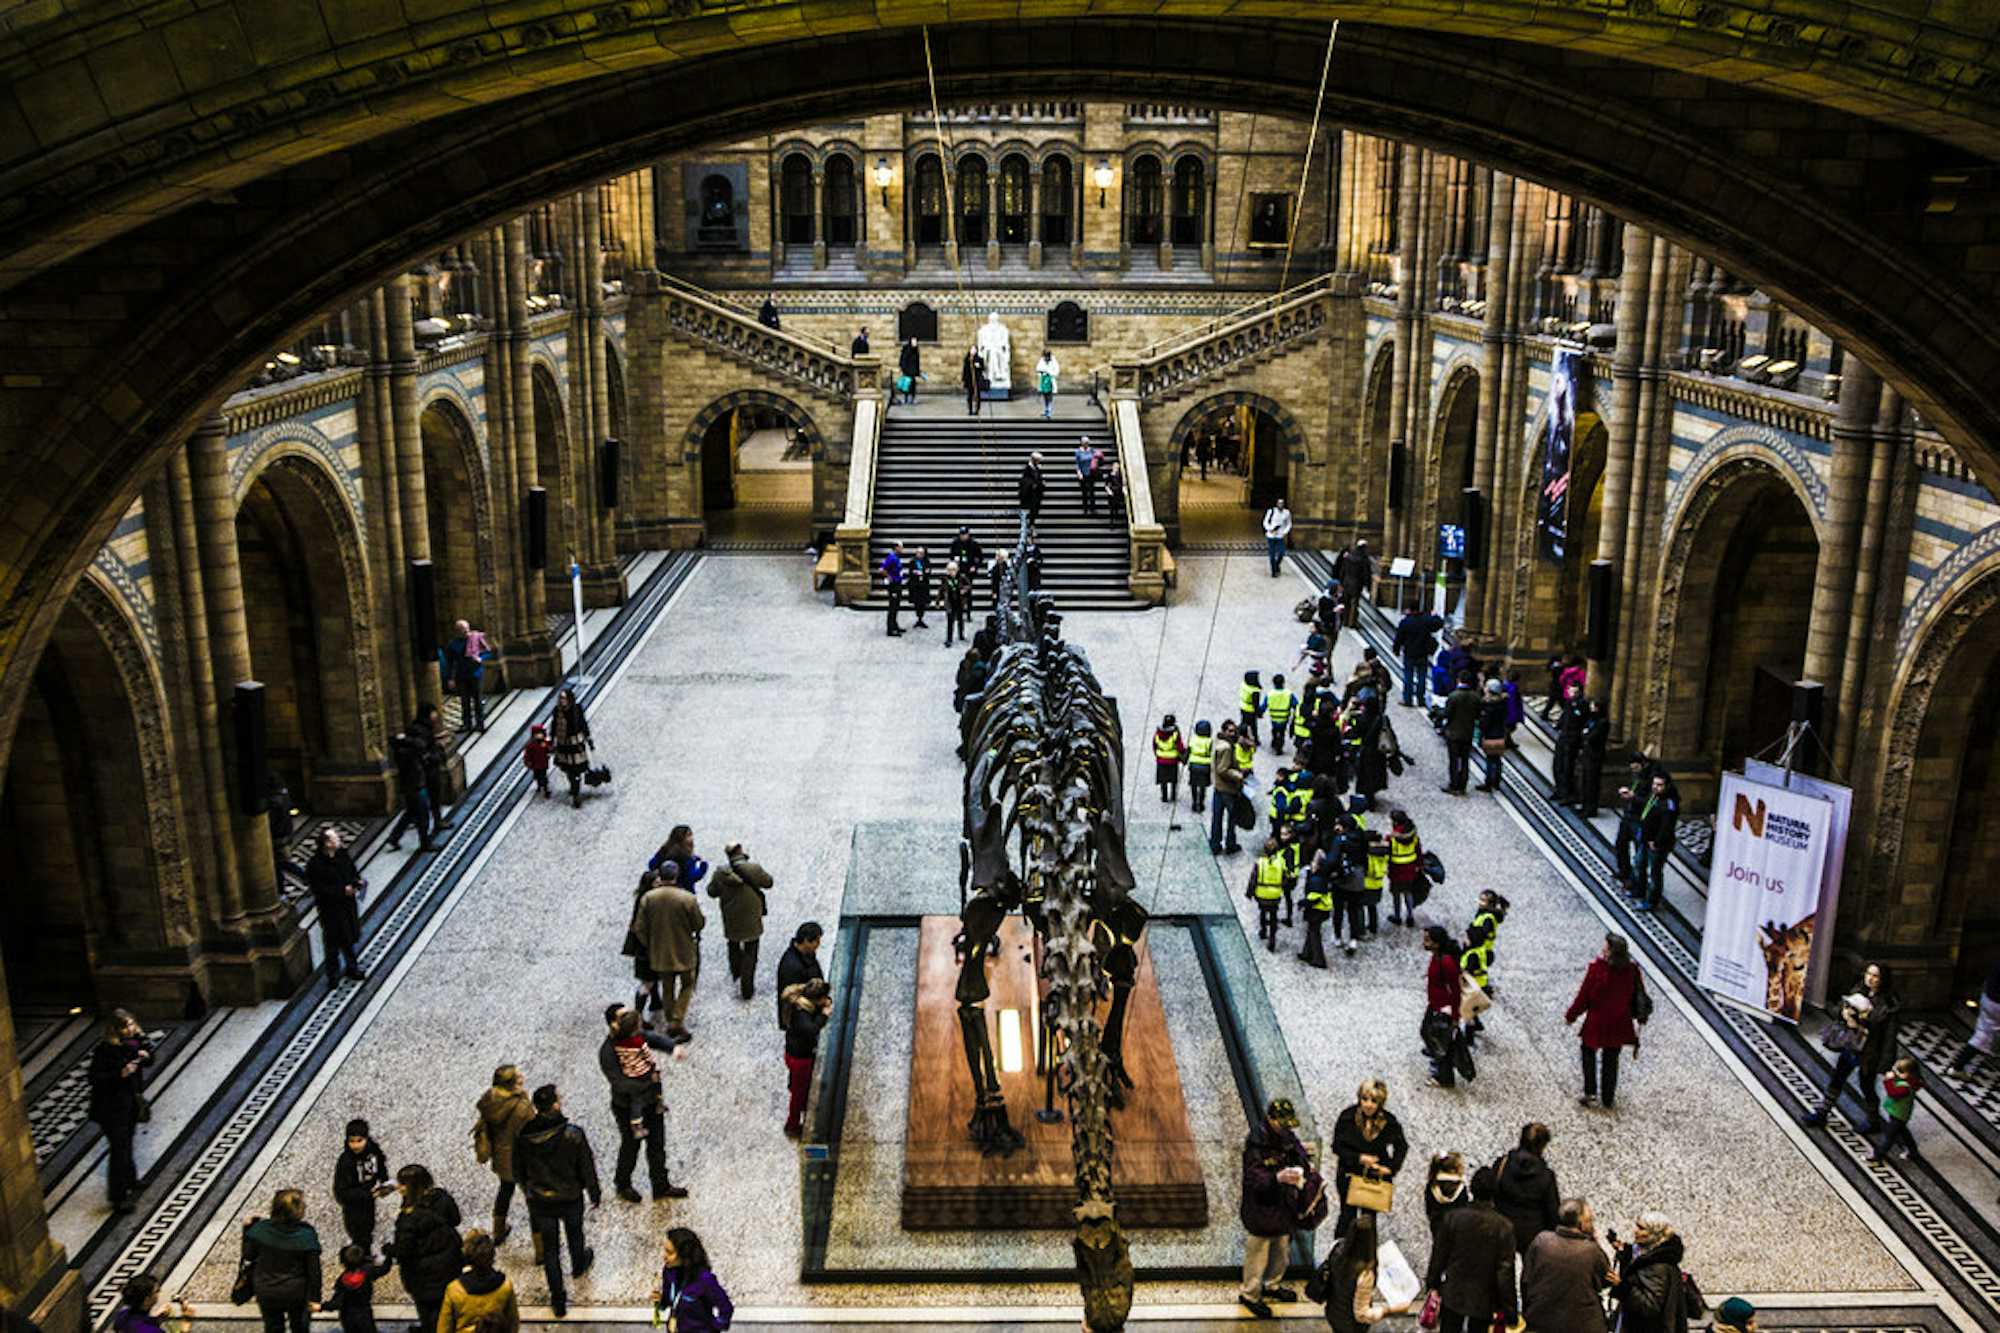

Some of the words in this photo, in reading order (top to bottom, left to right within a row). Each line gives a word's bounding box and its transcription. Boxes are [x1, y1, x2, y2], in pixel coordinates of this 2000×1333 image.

[1733, 792, 1766, 838] N
[1767, 812, 1811, 832] NATURAL
[1766, 821, 1811, 841] HISTORY
[1765, 832, 1809, 851] MUSEUM
[1726, 861, 1760, 886] Join
[1765, 877, 1785, 894] us
